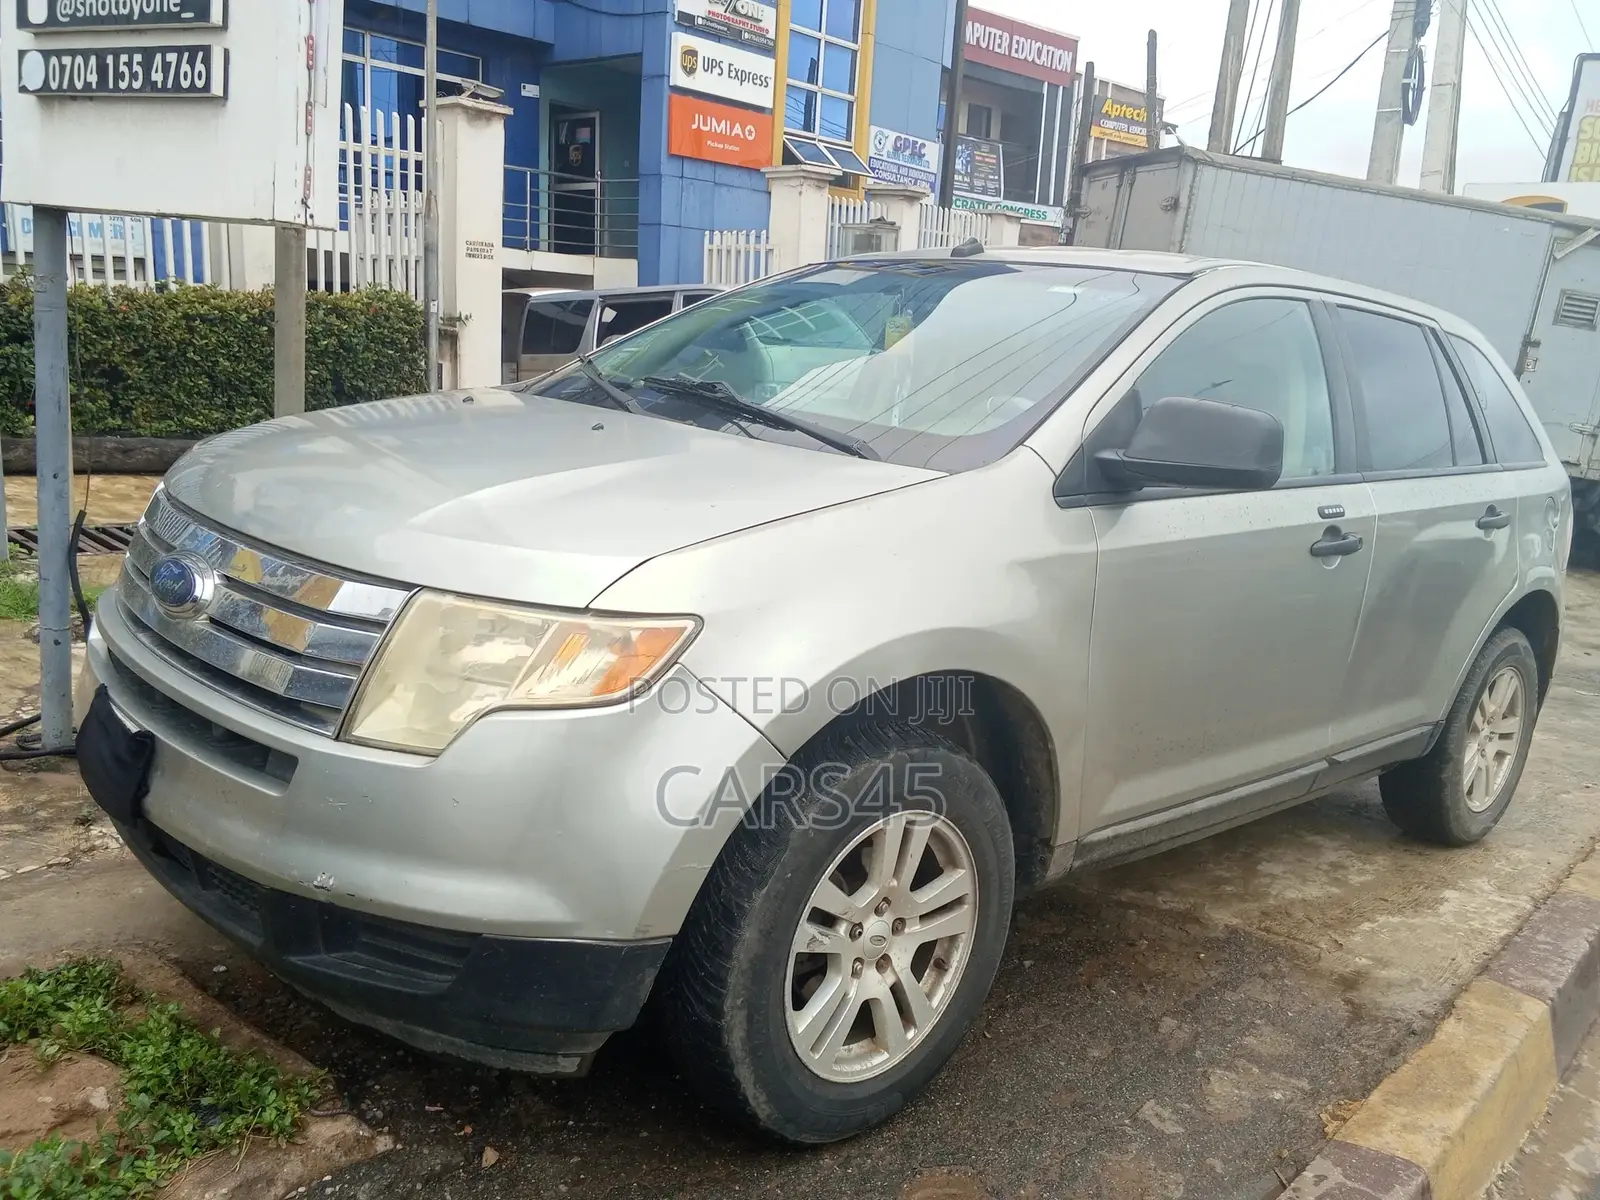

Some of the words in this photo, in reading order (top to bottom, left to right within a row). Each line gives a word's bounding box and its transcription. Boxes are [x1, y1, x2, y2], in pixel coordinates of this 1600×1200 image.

[707, 10, 749, 28] PHOTOGRAPHY
[682, 53, 697, 72] ups
[1010, 35, 1073, 73] EDUCATION
[49, 55, 98, 90] 0704
[106, 54, 143, 89] 155
[151, 51, 207, 89] 4766
[702, 55, 724, 76] UPS
[727, 63, 769, 88] Express
[1101, 98, 1147, 123] Aptech
[691, 113, 744, 139] JUMIA
[1100, 119, 1128, 132] COMPUTER
[892, 135, 926, 158] GPEC
[874, 169, 916, 186] CONSULTANCY
